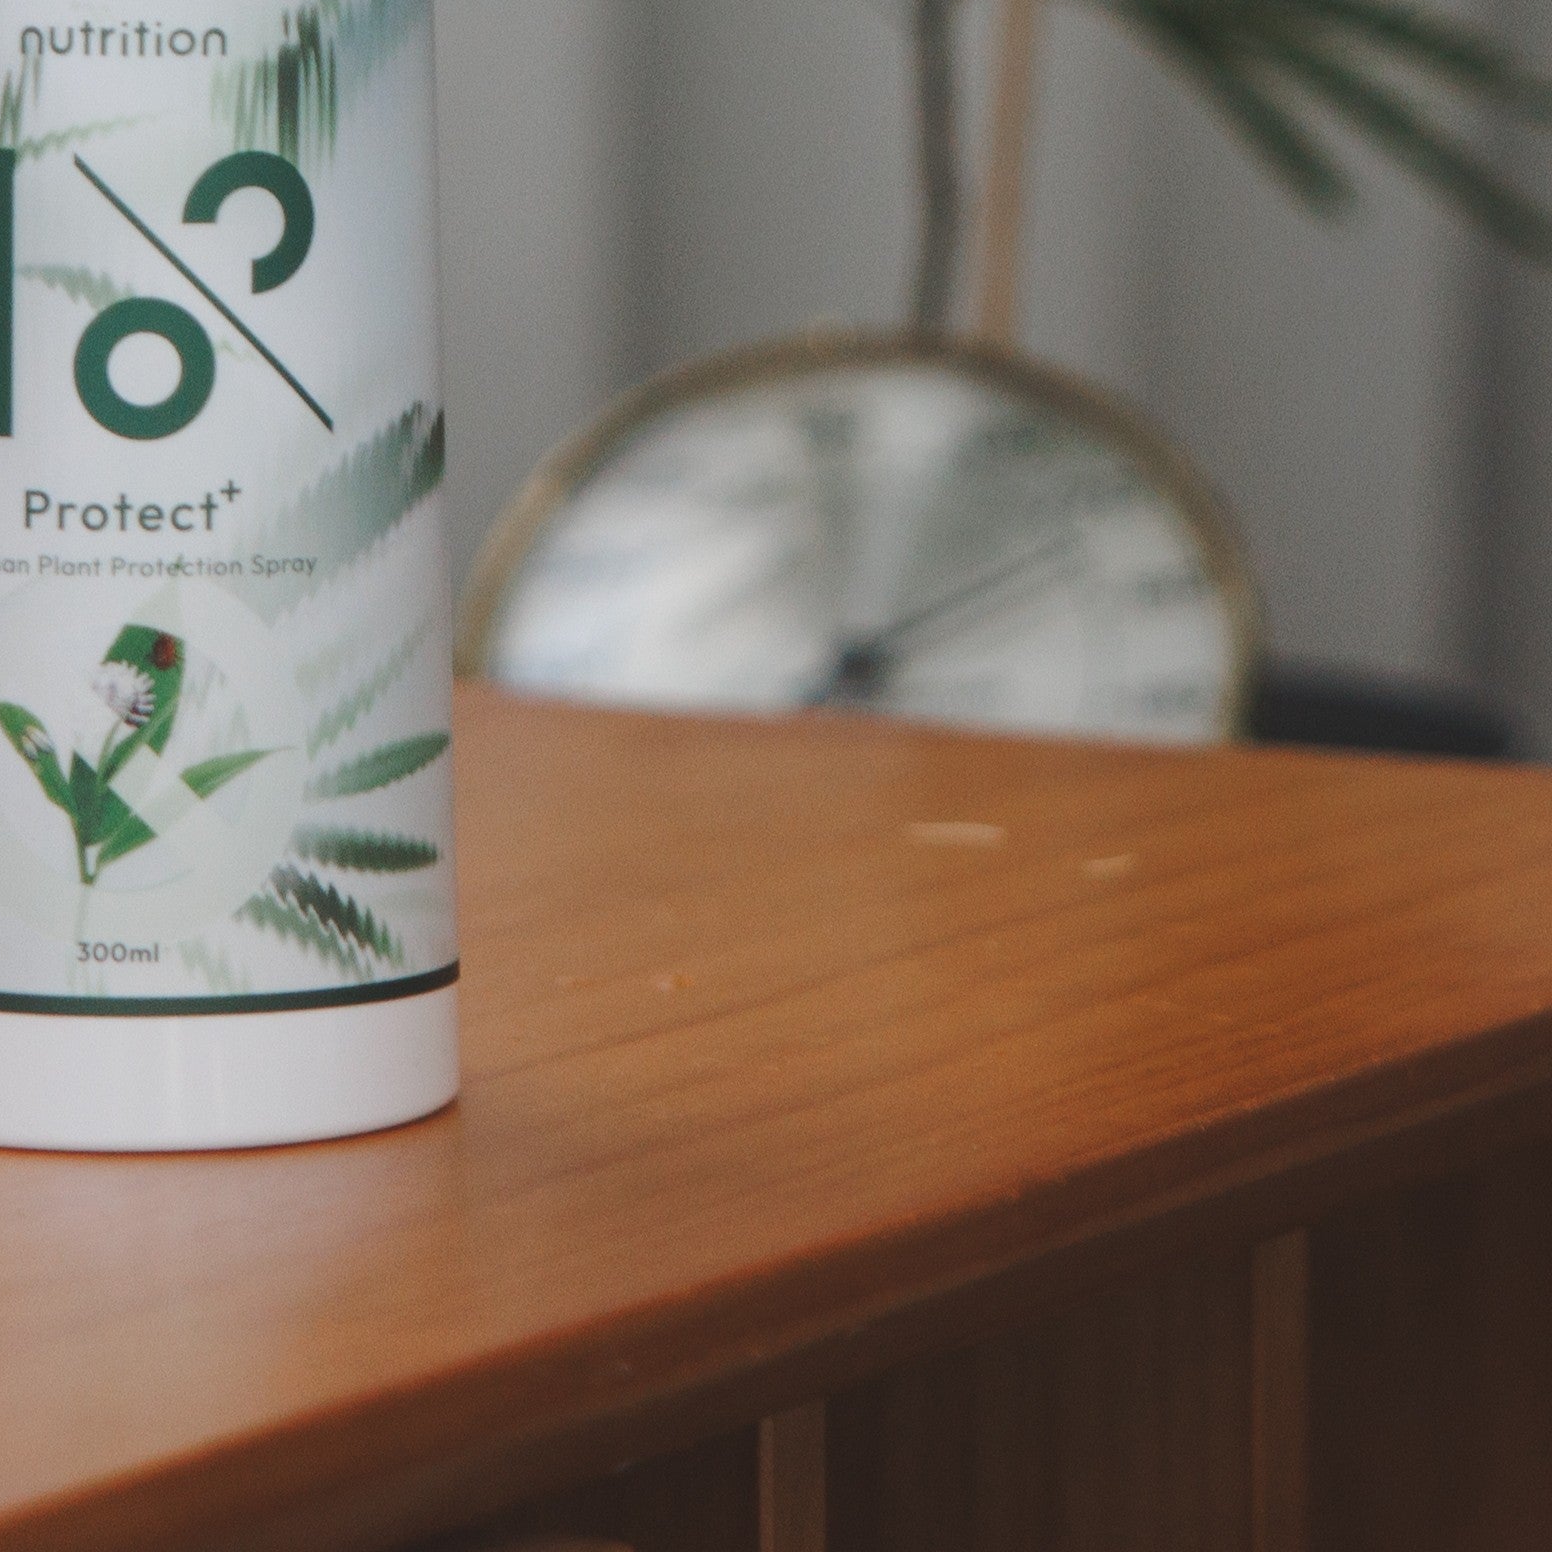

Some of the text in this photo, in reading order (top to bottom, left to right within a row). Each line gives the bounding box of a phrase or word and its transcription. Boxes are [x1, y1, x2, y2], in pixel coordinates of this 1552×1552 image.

[20, 21, 228, 58] nutrition
[38, 552, 101, 577] Plant
[111, 551, 243, 578] Protection
[251, 552, 318, 580] Spray
[76, 941, 160, 964] 300ml
